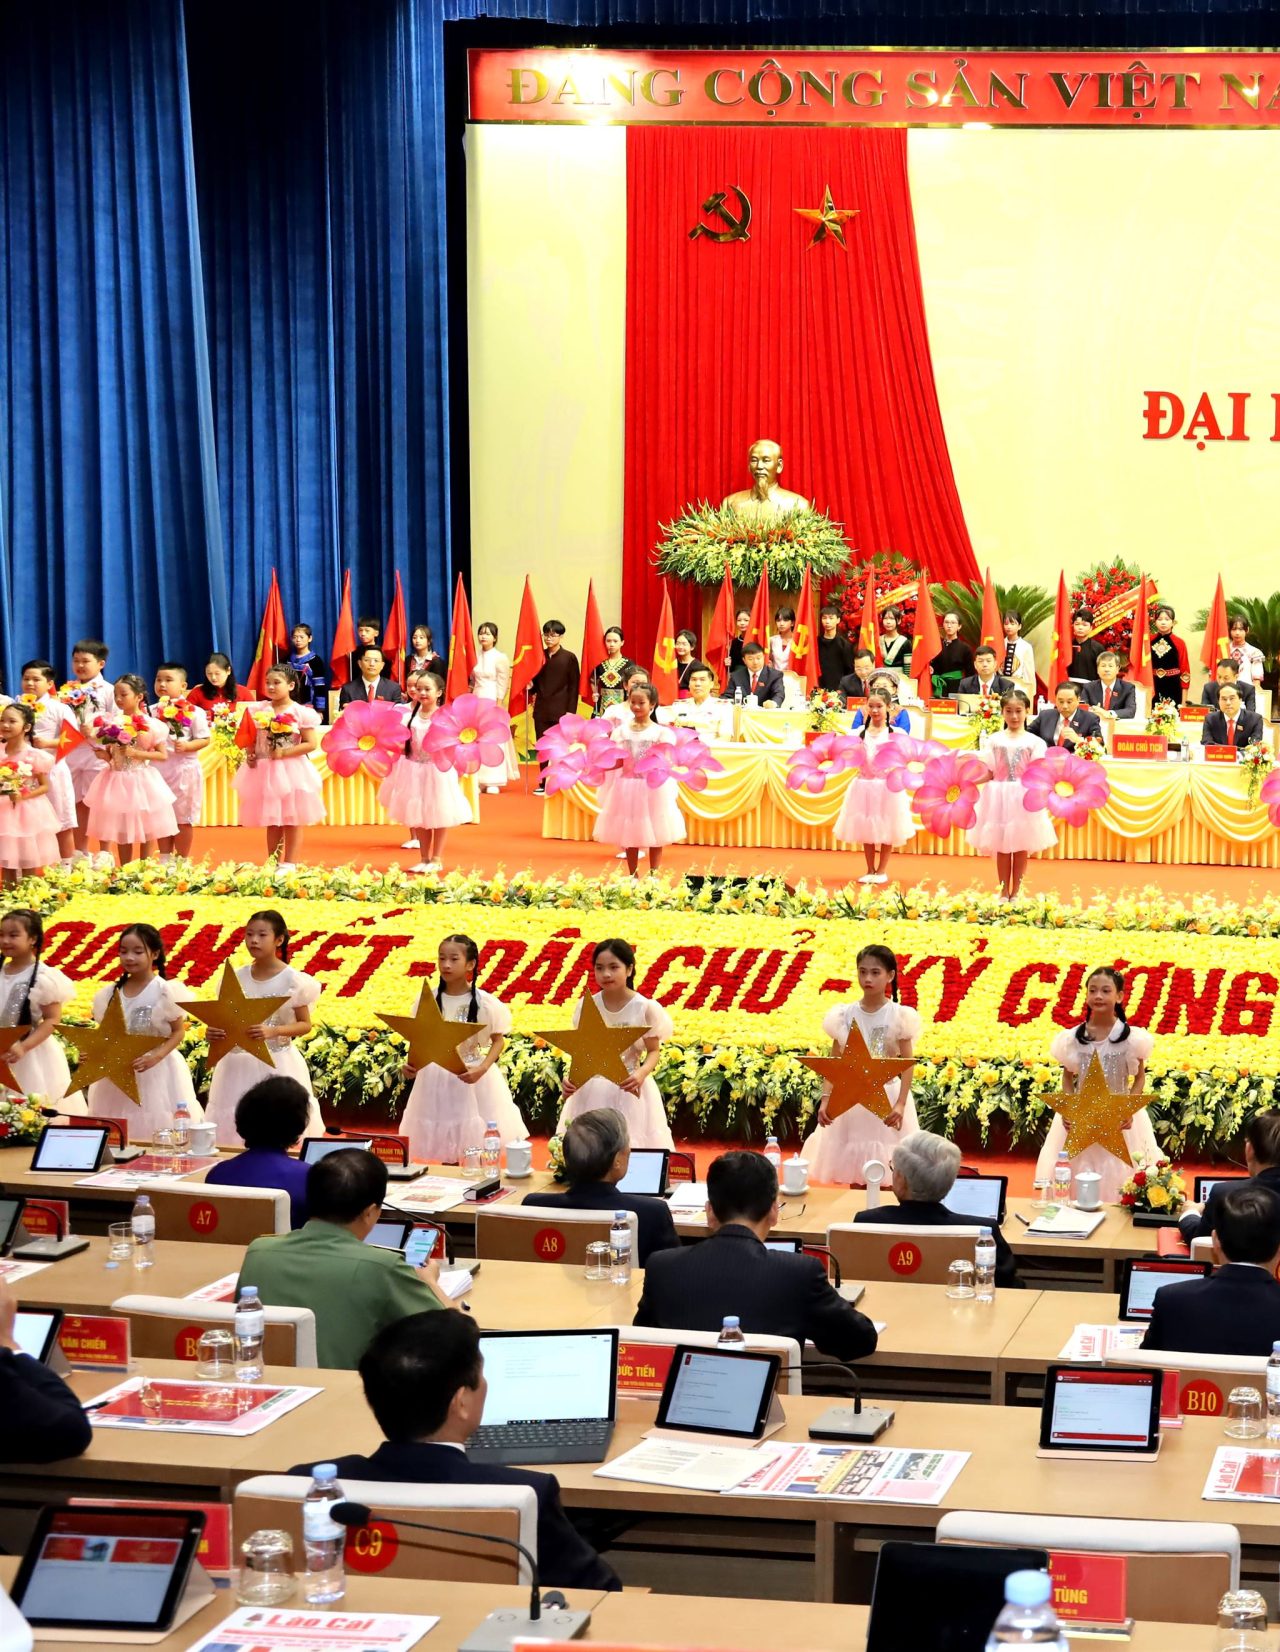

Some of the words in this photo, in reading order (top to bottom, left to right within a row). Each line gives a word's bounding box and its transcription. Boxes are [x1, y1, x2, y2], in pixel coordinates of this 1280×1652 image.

[703, 57, 888, 117] CỘNG
[905, 58, 1030, 110] SẢN
[1048, 60, 1201, 119] VIỆT
[1142, 391, 1251, 453] ĐẠI
[637, 929, 815, 1015] CHỦ
[196, 1210, 212, 1225] A7
[541, 1236, 558, 1252] A8
[896, 1250, 913, 1266] A9
[635, 1363, 656, 1378] TIẾN
[1187, 1390, 1217, 1412] B10
[355, 1528, 382, 1556] C9
[1054, 1585, 1088, 1605] TÙNG
[325, 1617, 375, 1630] Cai
